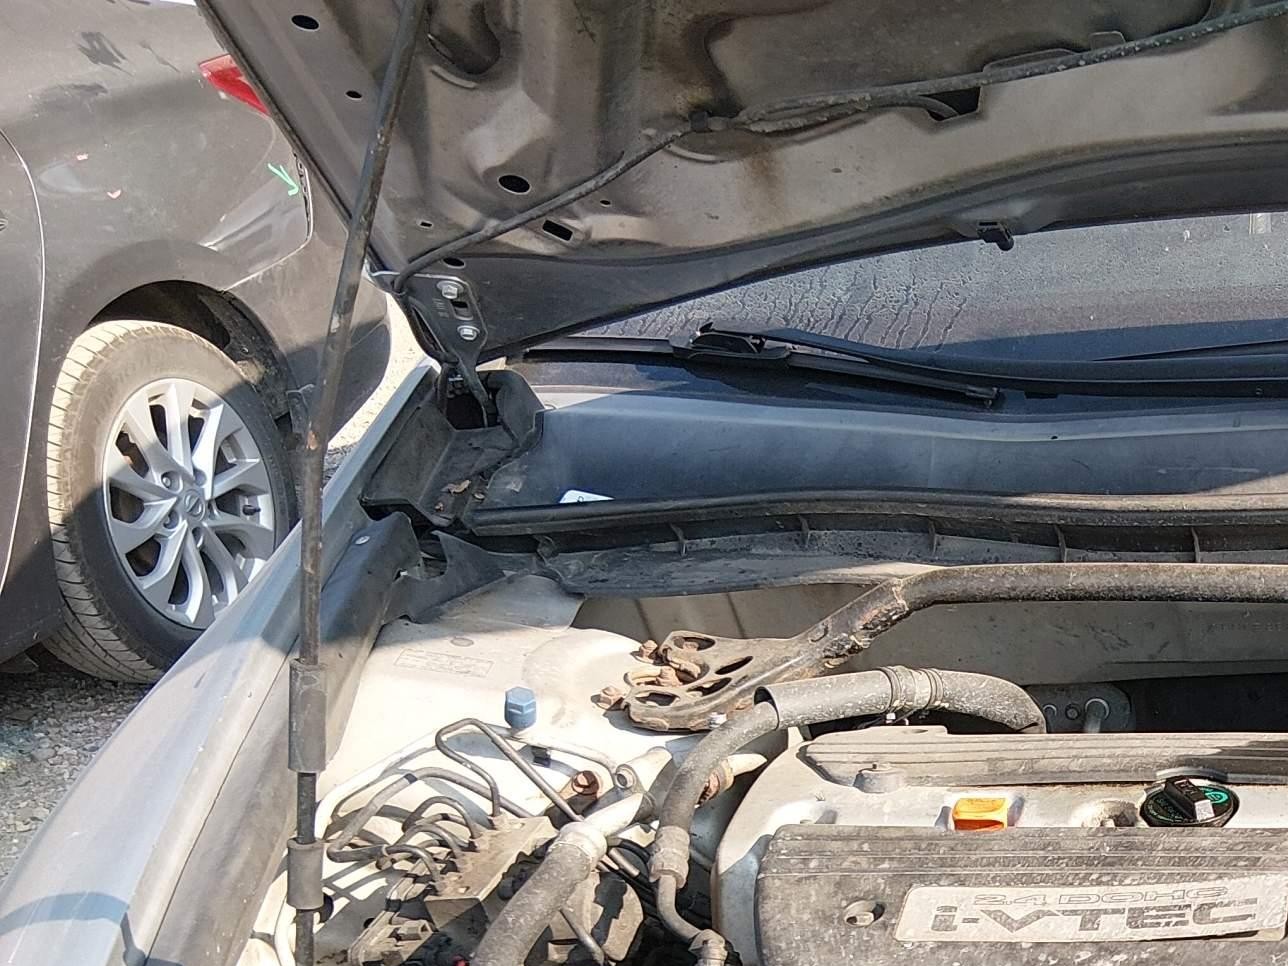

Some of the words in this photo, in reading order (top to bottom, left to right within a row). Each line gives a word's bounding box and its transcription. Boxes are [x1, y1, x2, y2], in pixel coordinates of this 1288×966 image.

[973, 893, 1047, 906] 2.4
[1058, 886, 1228, 905] DOHC
[930, 898, 1258, 933] i-VTEC
